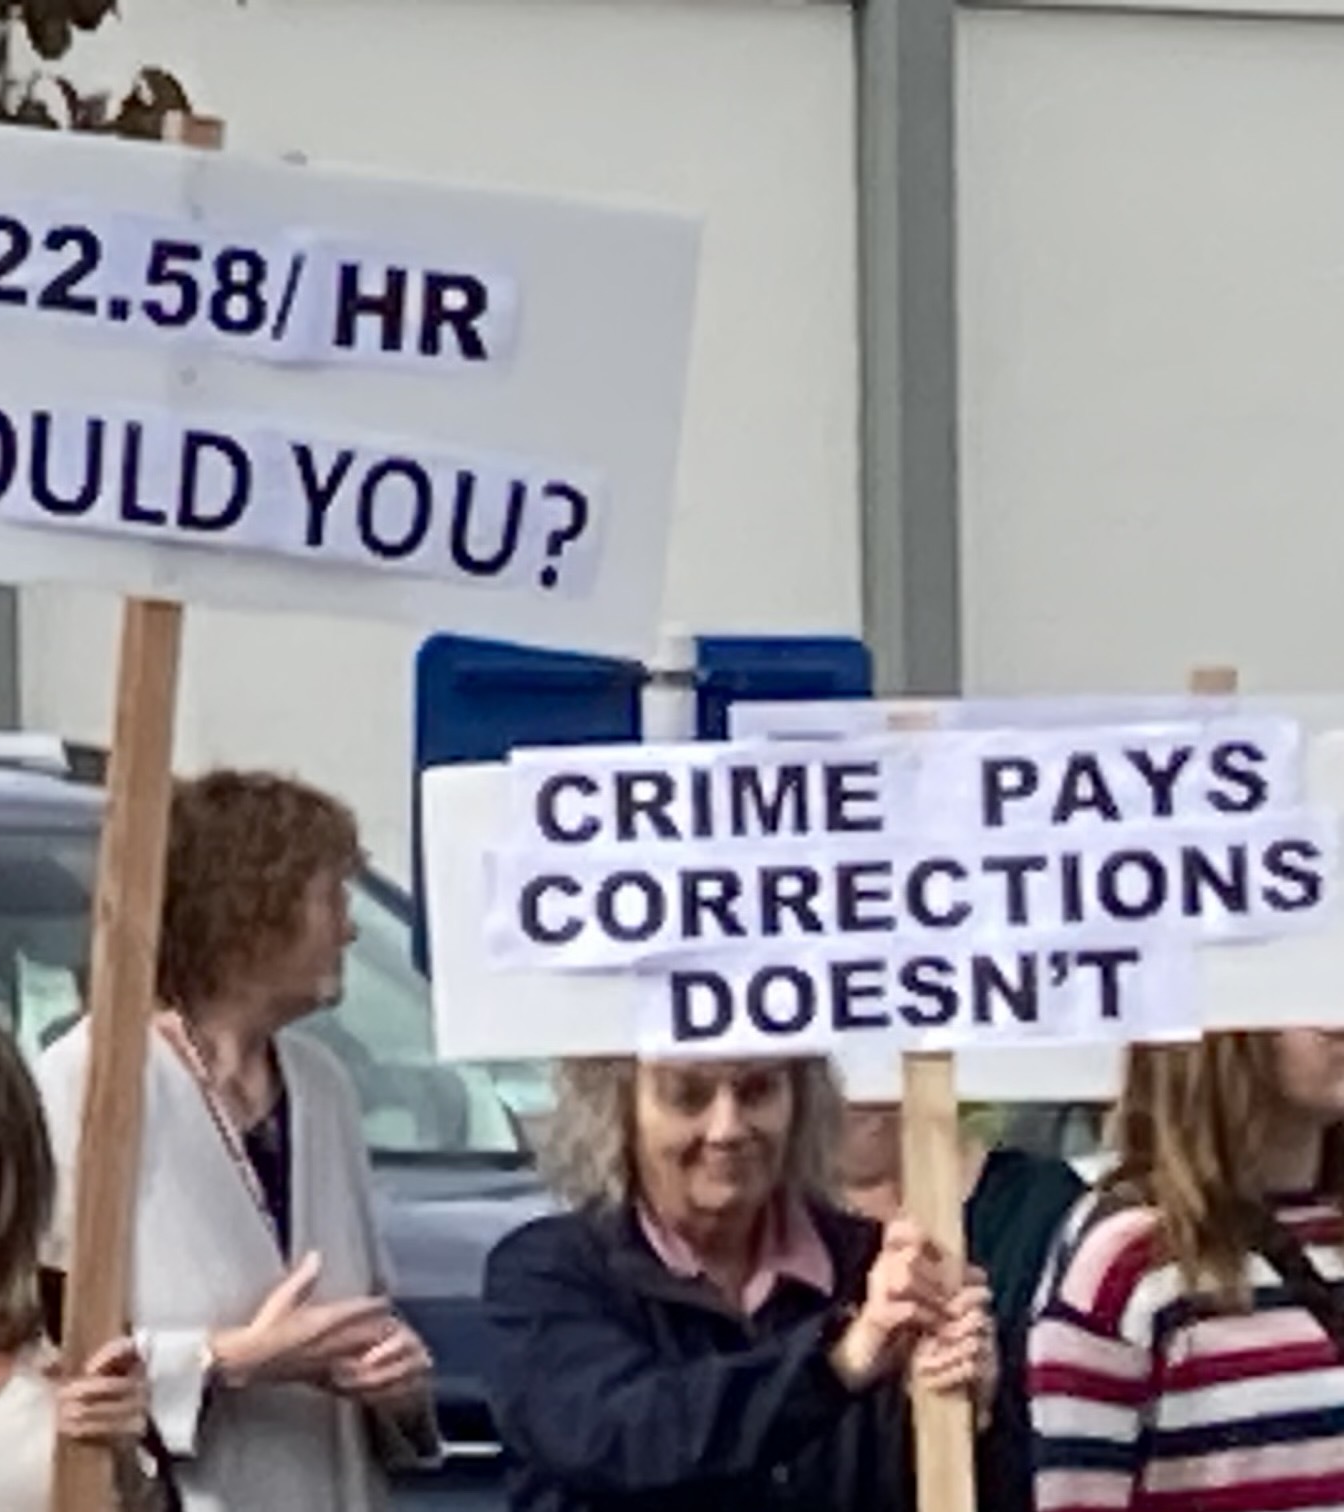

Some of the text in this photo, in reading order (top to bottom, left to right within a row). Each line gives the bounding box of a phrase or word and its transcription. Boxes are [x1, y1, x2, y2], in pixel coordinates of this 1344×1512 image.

[332, 262, 488, 361] HR
[291, 443, 590, 589] YOU?
[535, 742, 1269, 843] CRIME PAYS
[519, 839, 1324, 943] CORRECTIONS
[669, 948, 1141, 1041] DOESN'T
